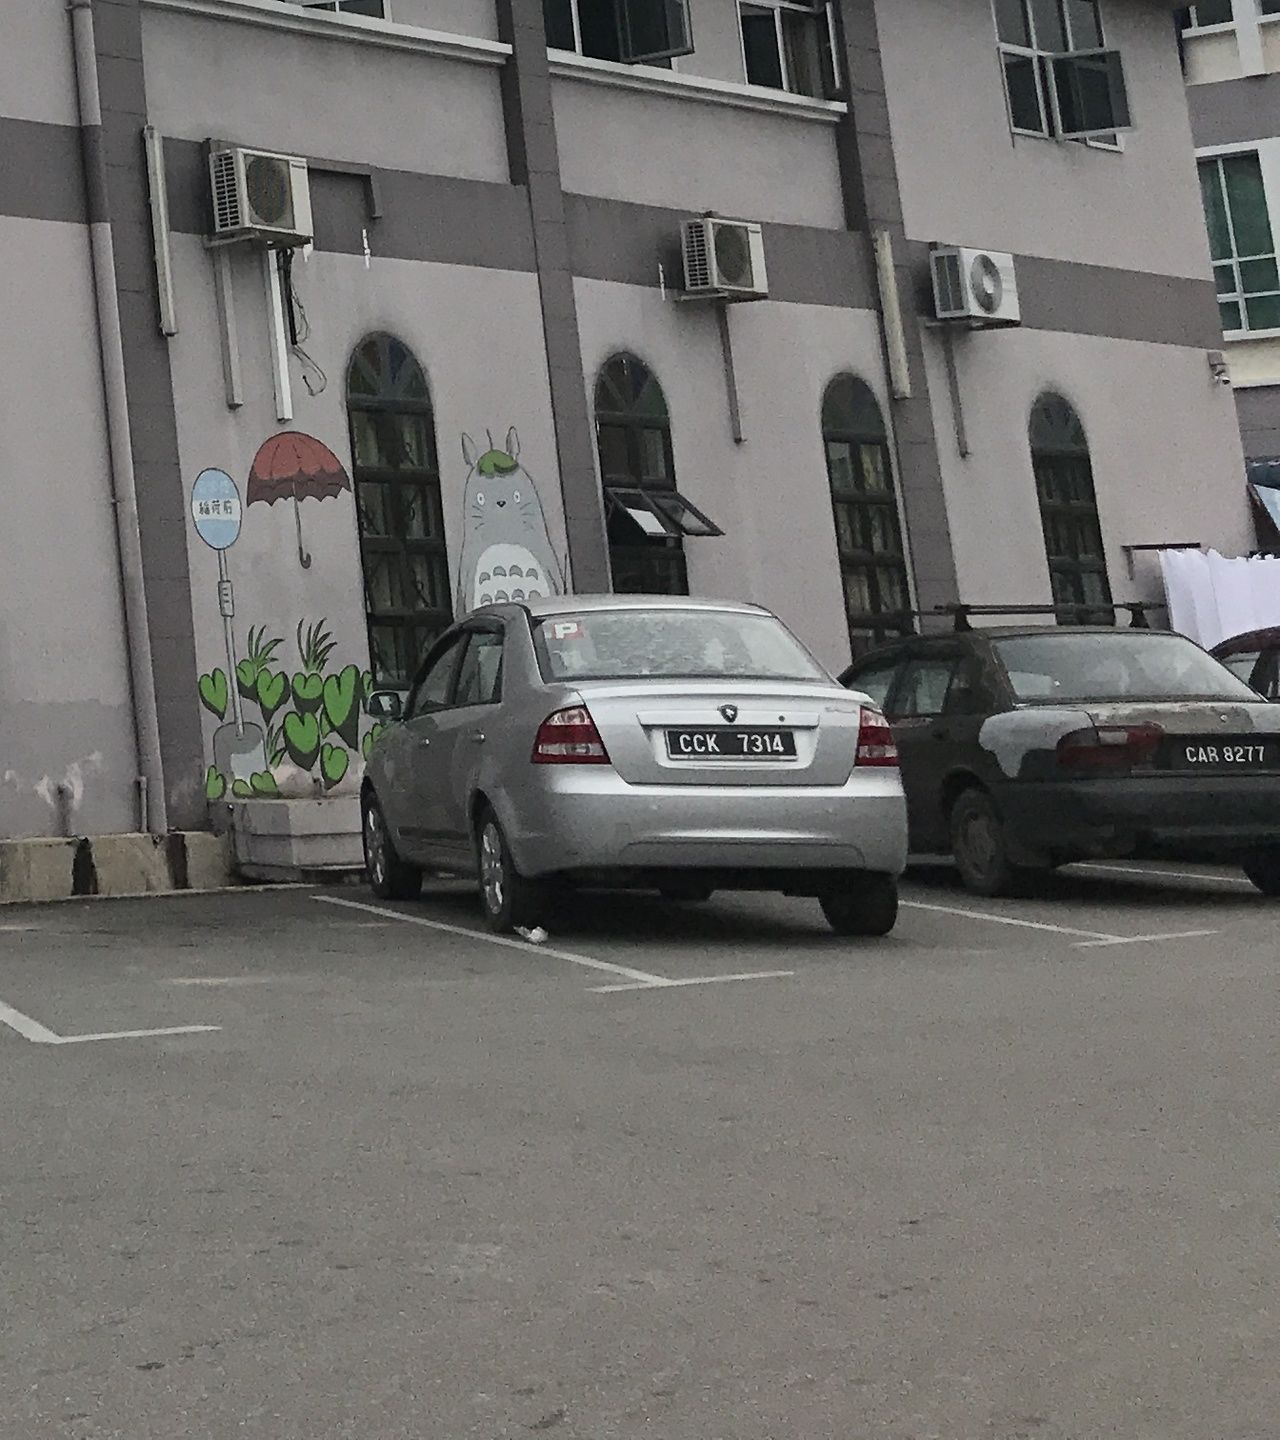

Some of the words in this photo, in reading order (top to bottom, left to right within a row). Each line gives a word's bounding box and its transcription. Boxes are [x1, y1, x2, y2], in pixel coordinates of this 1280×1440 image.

[554, 622, 578, 639] P
[679, 733, 721, 753] CCK
[737, 733, 785, 753] 7314
[1185, 746, 1220, 762] CAR
[1223, 746, 1265, 762] 8277
